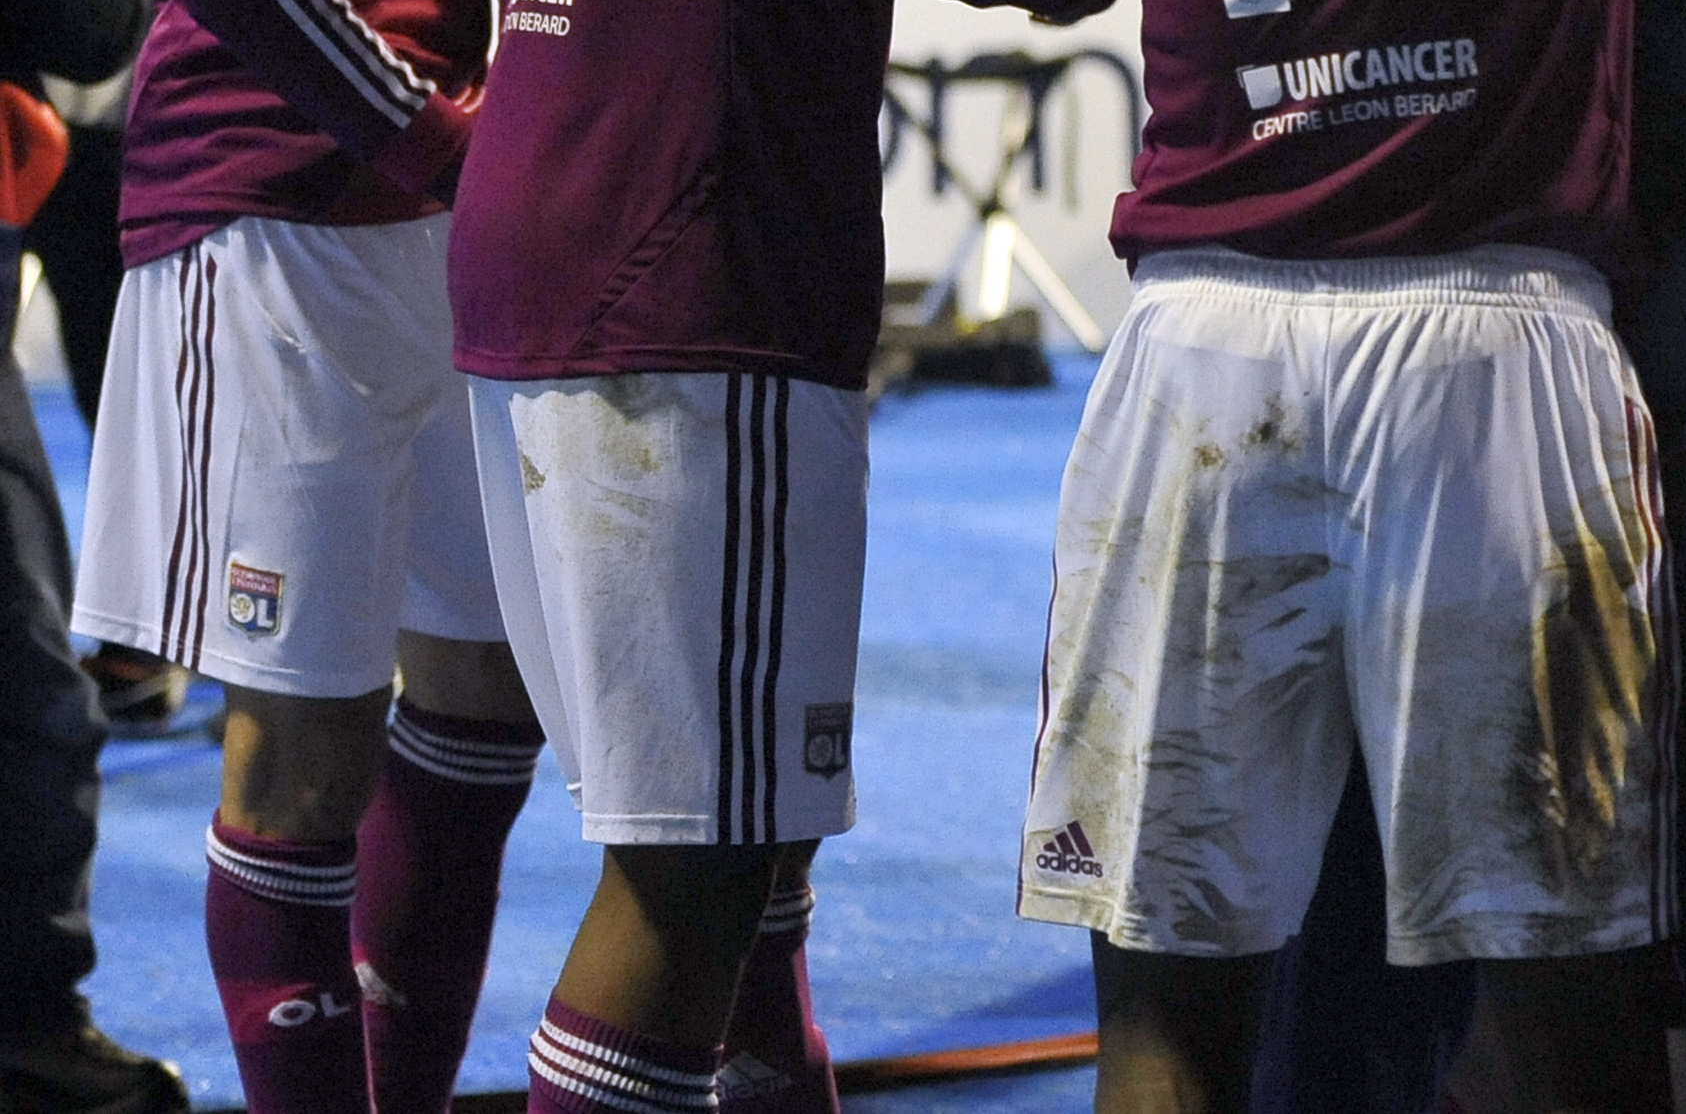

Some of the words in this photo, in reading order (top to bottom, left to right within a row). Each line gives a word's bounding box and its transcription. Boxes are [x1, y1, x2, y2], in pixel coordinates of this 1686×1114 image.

[519, 11, 571, 36] BERARD
[1283, 38, 1479, 101] UNICANCER
[1252, 109, 1323, 141] CENTRE
[1328, 99, 1390, 127] LEON
[1394, 88, 1476, 118] BERARD
[1036, 853, 1104, 879] adidas
[268, 992, 351, 1028] OL
